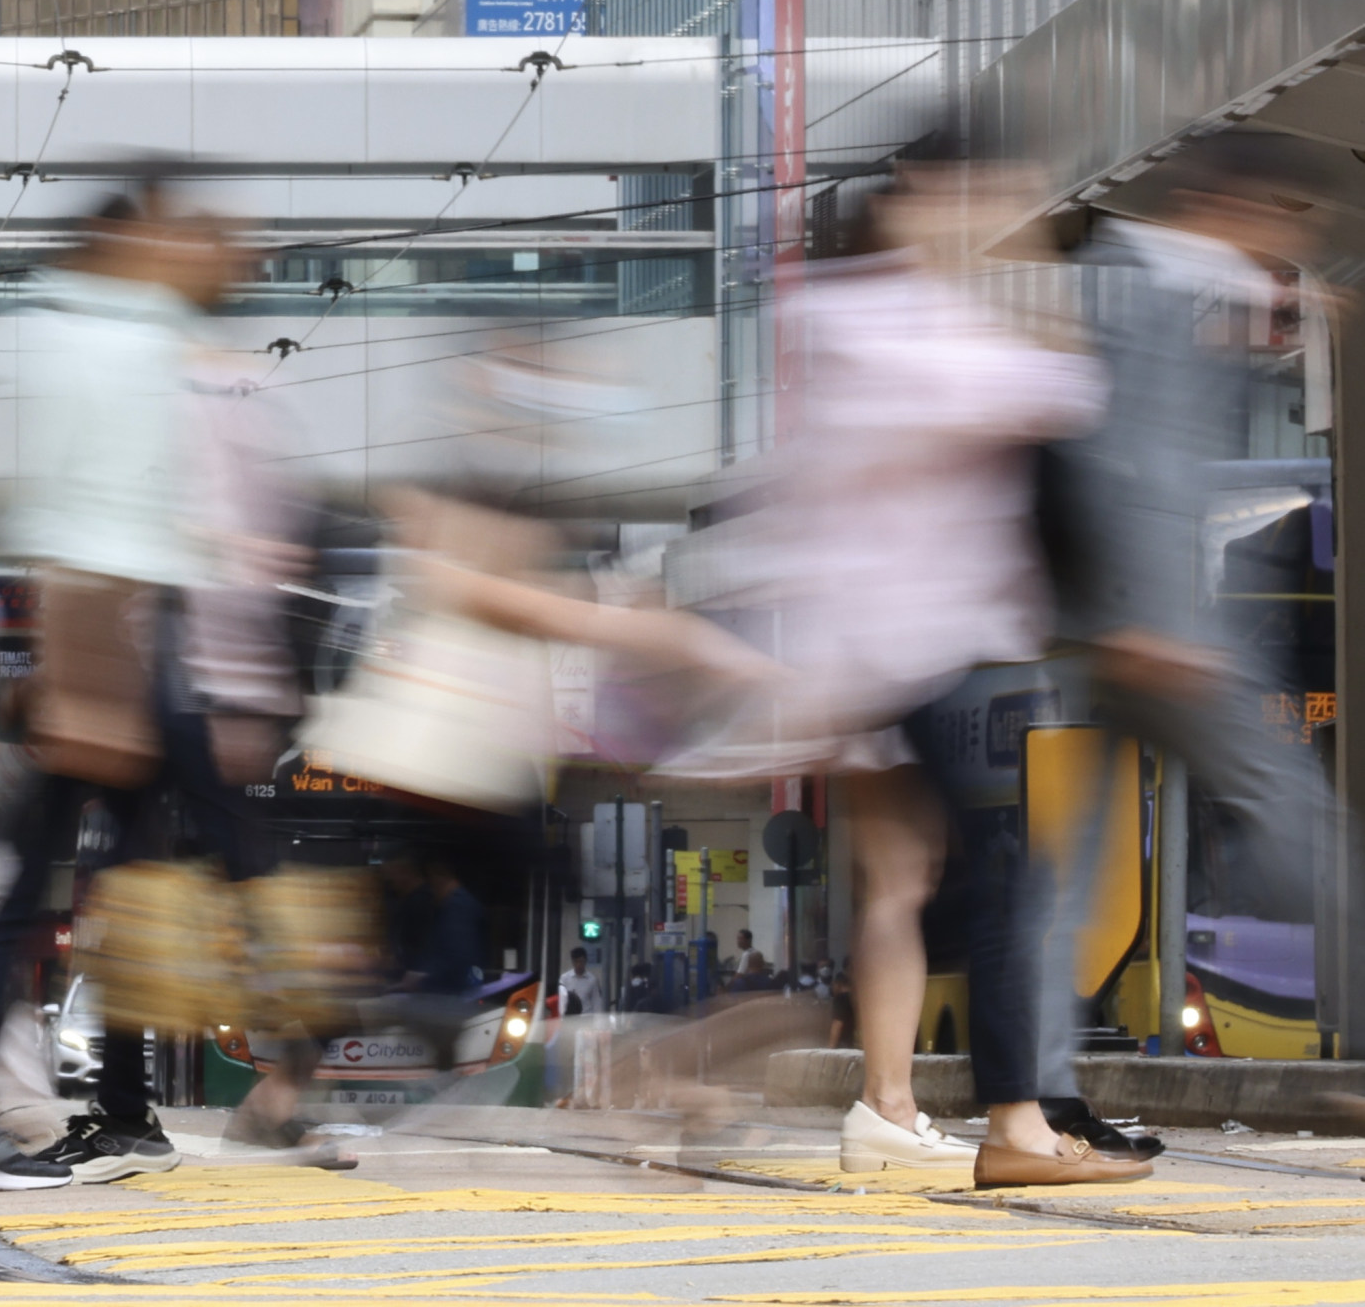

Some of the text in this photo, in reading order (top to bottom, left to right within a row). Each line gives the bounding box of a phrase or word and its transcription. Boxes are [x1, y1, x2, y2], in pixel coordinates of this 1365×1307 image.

[523, 11, 565, 32] 2781
[245, 784, 276, 798] 6125
[291, 774, 334, 792] Wan
[366, 1042, 425, 1059] Citybus
